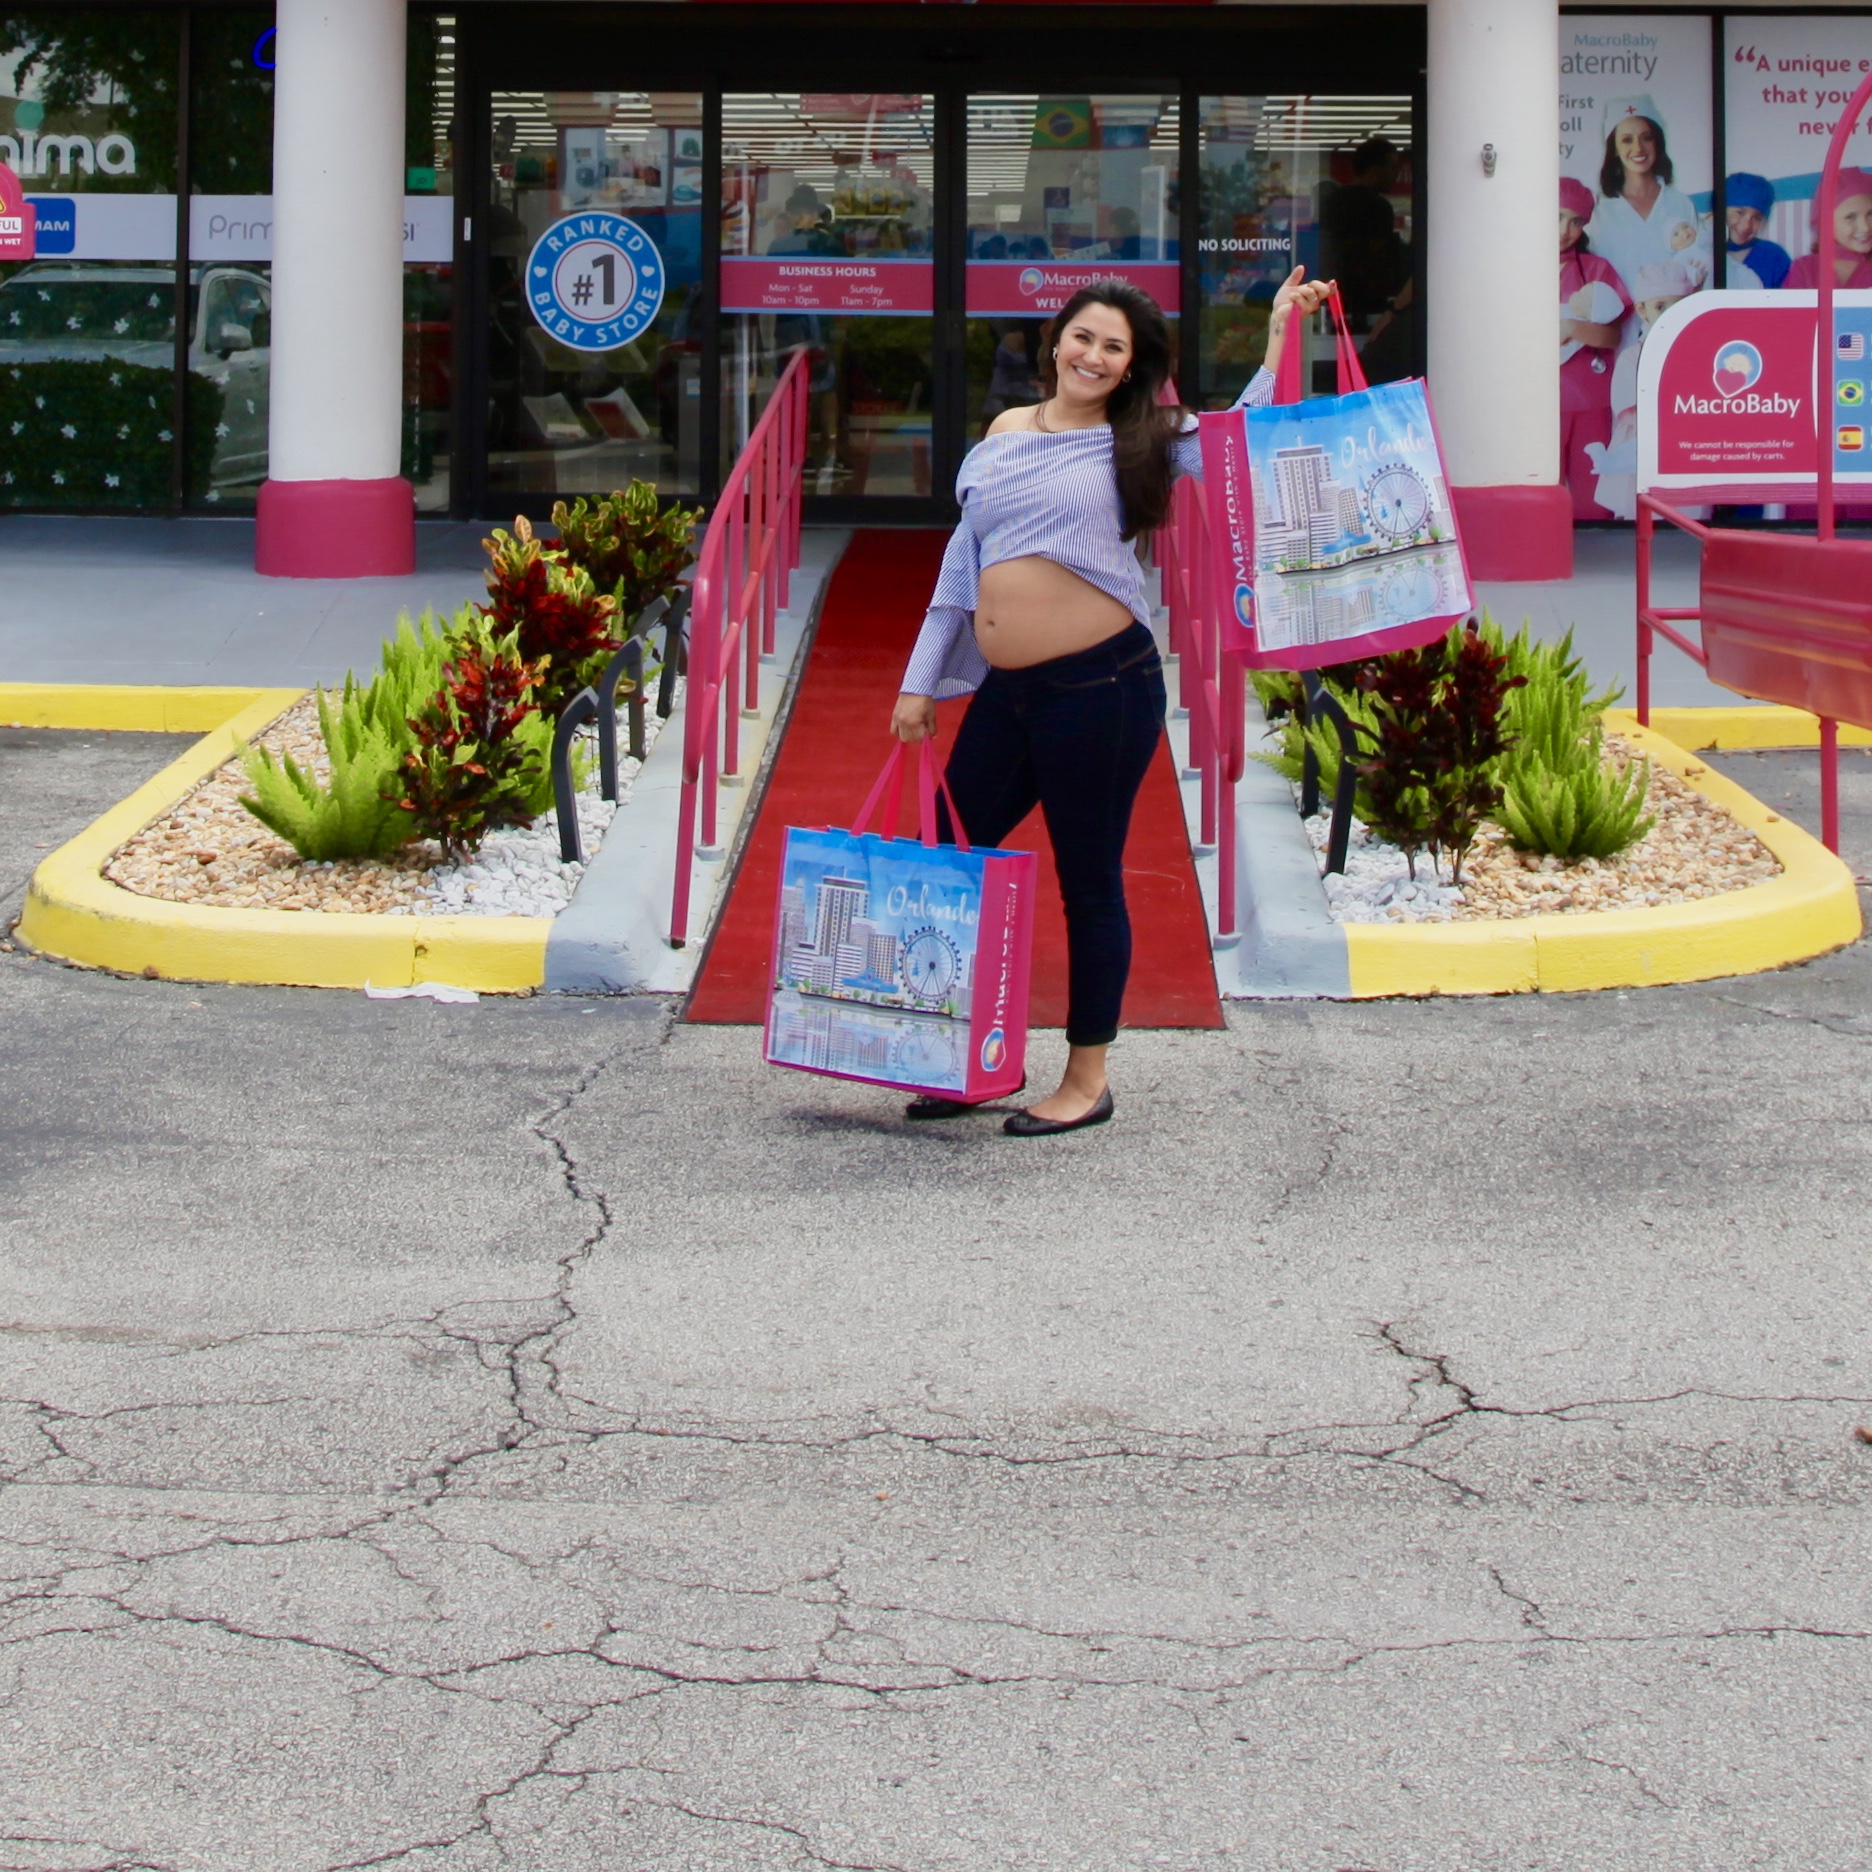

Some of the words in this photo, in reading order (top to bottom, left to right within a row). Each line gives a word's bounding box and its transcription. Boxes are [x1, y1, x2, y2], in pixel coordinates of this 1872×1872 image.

[1574, 33, 1658, 51] MacroBaby
[1560, 49, 1658, 81] aternity
[1778, 54, 1851, 77] unique
[1762, 85, 1807, 104] that
[1815, 90, 1856, 109] you
[1799, 121, 1859, 135] nevr
[209, 214, 273, 240] Prim
[546, 218, 644, 252] RANKED
[1198, 239, 1218, 252] NO
[1220, 238, 1291, 252] SOLICITING
[571, 254, 615, 306] #1
[779, 266, 833, 277] BUSINESS
[835, 267, 876, 277] HOURS
[769, 283, 790, 292] Mon
[798, 283, 813, 292] Sat
[850, 284, 884, 295] Sunday
[762, 295, 786, 305] 10am
[794, 296, 820, 307] 10pm
[841, 296, 863, 306] 11am
[872, 297, 893, 308] 7pm
[534, 291, 585, 342] BABY
[595, 286, 658, 344] STORE
[1674, 392, 1801, 419] MacroBaby
[1340, 422, 1429, 469] Orlando
[1679, 441, 1692, 449] We
[1693, 441, 1721, 449] cannot
[1723, 440, 1733, 449] be
[1735, 440, 1780, 450] responsible
[1782, 439, 1795, 448] for
[1690, 452, 1721, 462] damage
[1723, 452, 1751, 461] caused
[1752, 452, 1762, 461] by
[1763, 452, 1785, 460] carts.
[886, 883, 979, 926] Orlando
